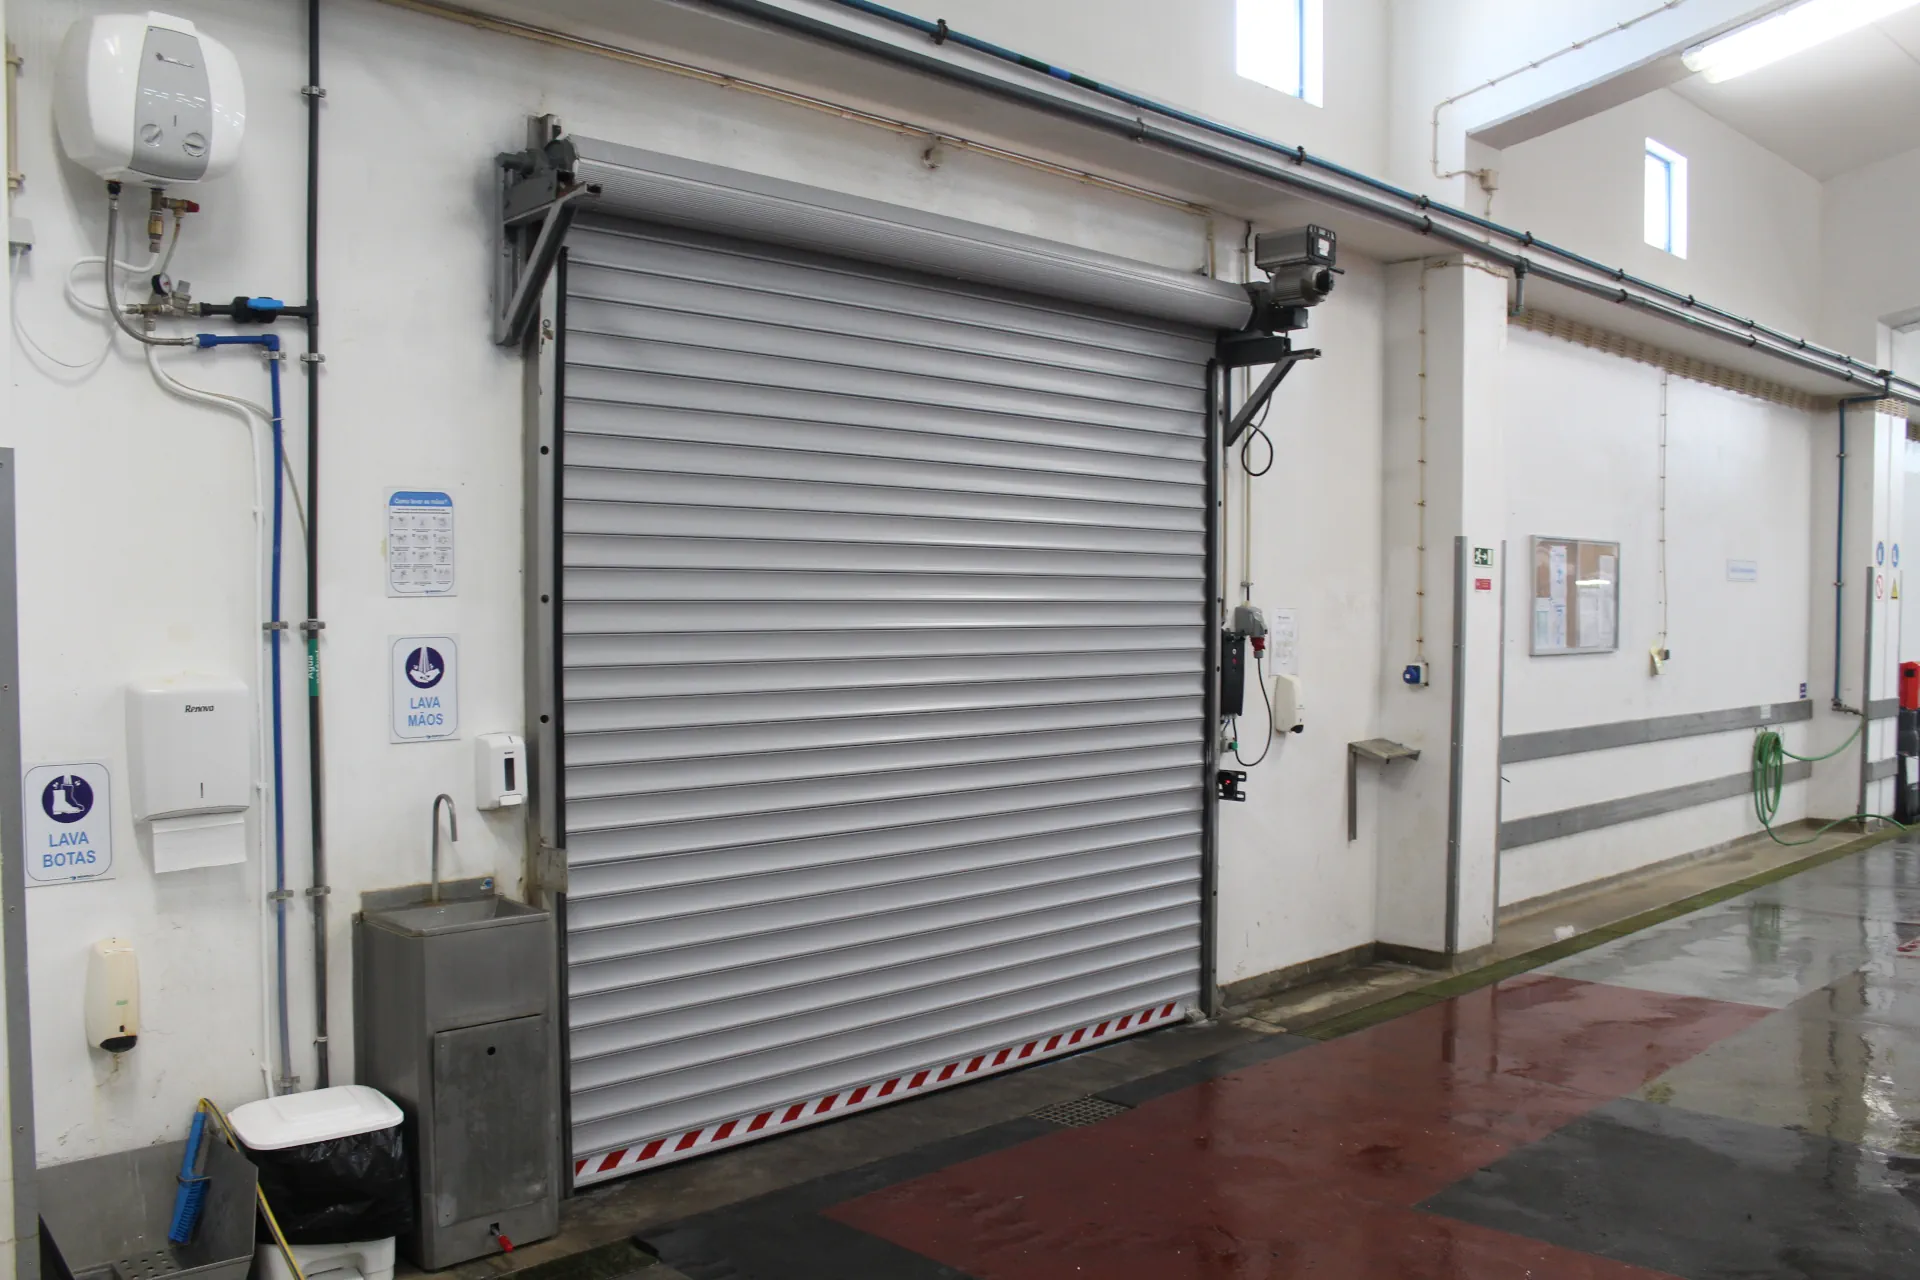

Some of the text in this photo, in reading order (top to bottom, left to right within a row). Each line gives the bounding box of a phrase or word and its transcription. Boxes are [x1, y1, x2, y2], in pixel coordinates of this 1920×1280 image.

[410, 696, 441, 709] LAVA
[407, 711, 444, 727] MÃOS
[48, 831, 90, 848] LAVA
[42, 850, 97, 868] BOTAS
